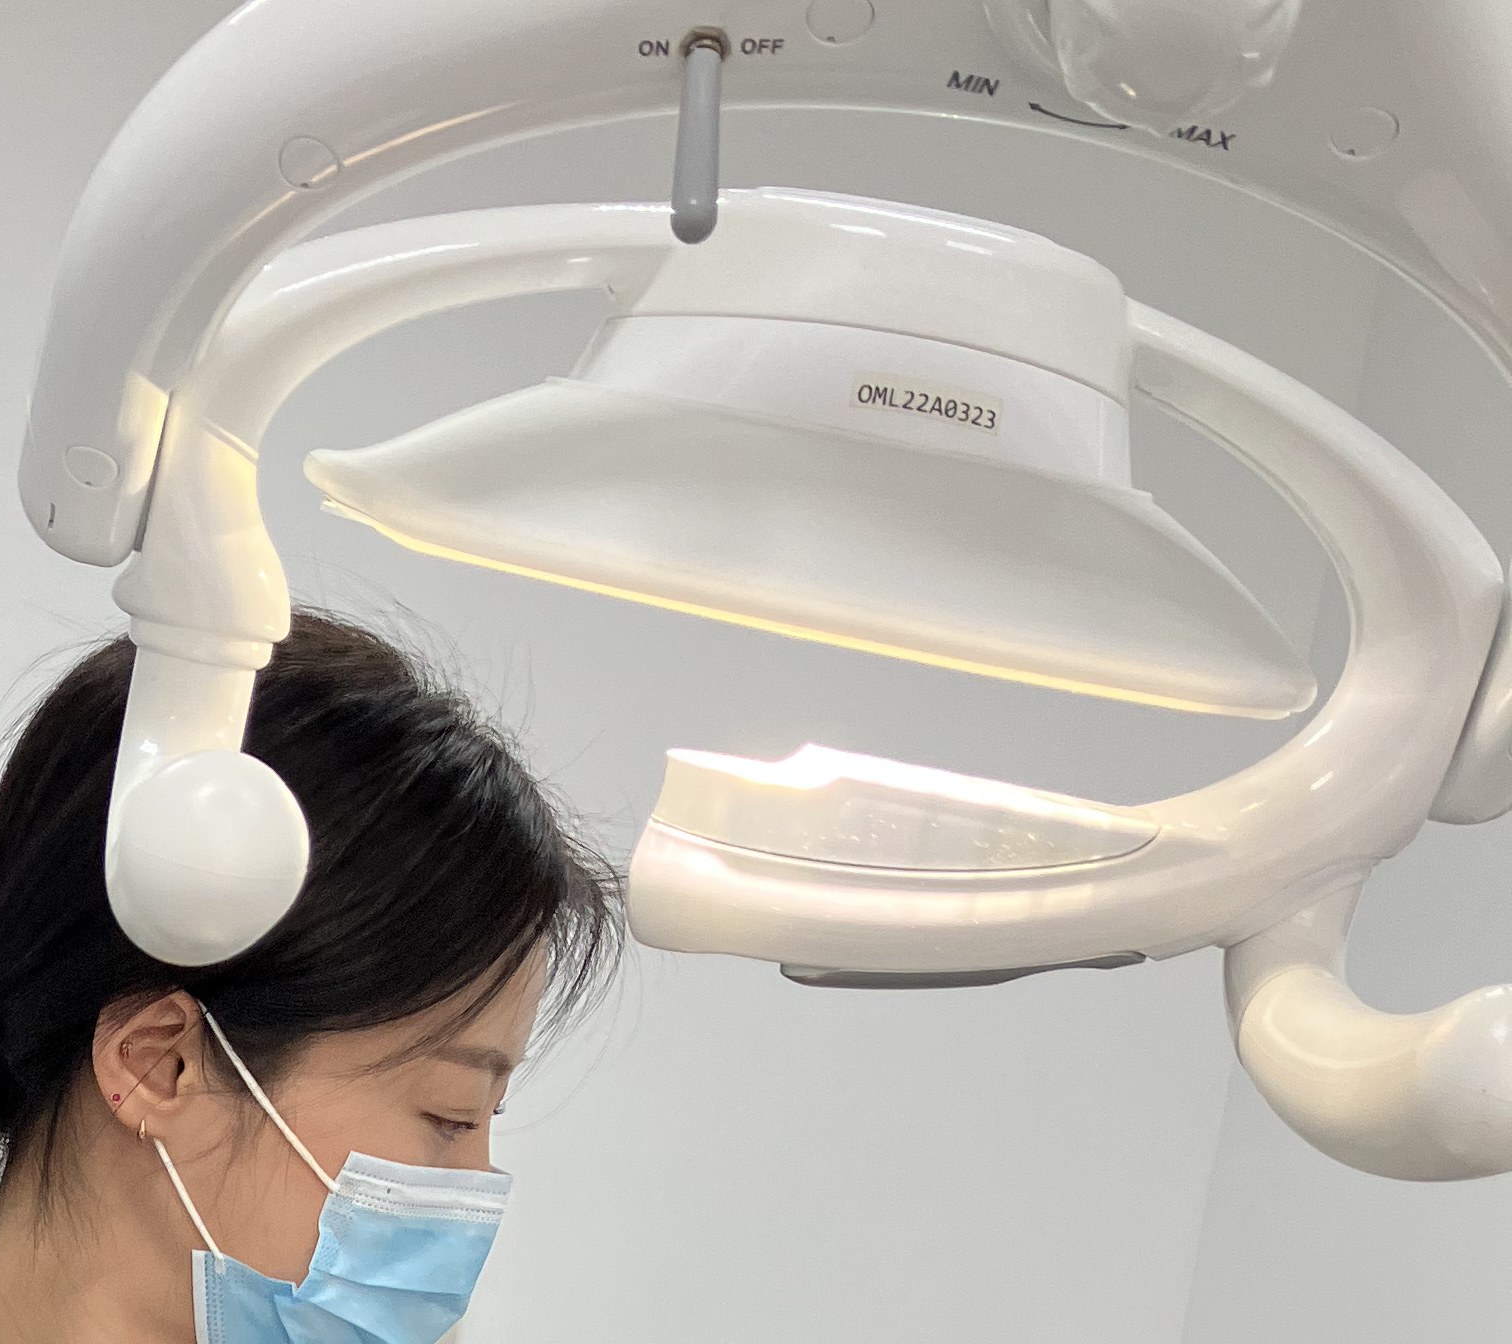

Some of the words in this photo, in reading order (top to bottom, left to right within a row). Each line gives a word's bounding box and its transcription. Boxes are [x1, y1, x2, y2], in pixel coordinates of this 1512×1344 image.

[637, 39, 670, 57] ON
[740, 37, 784, 56] OFF
[946, 69, 1000, 97] MIN
[1170, 124, 1236, 152] MAX
[857, 383, 997, 430] OML22A0323
